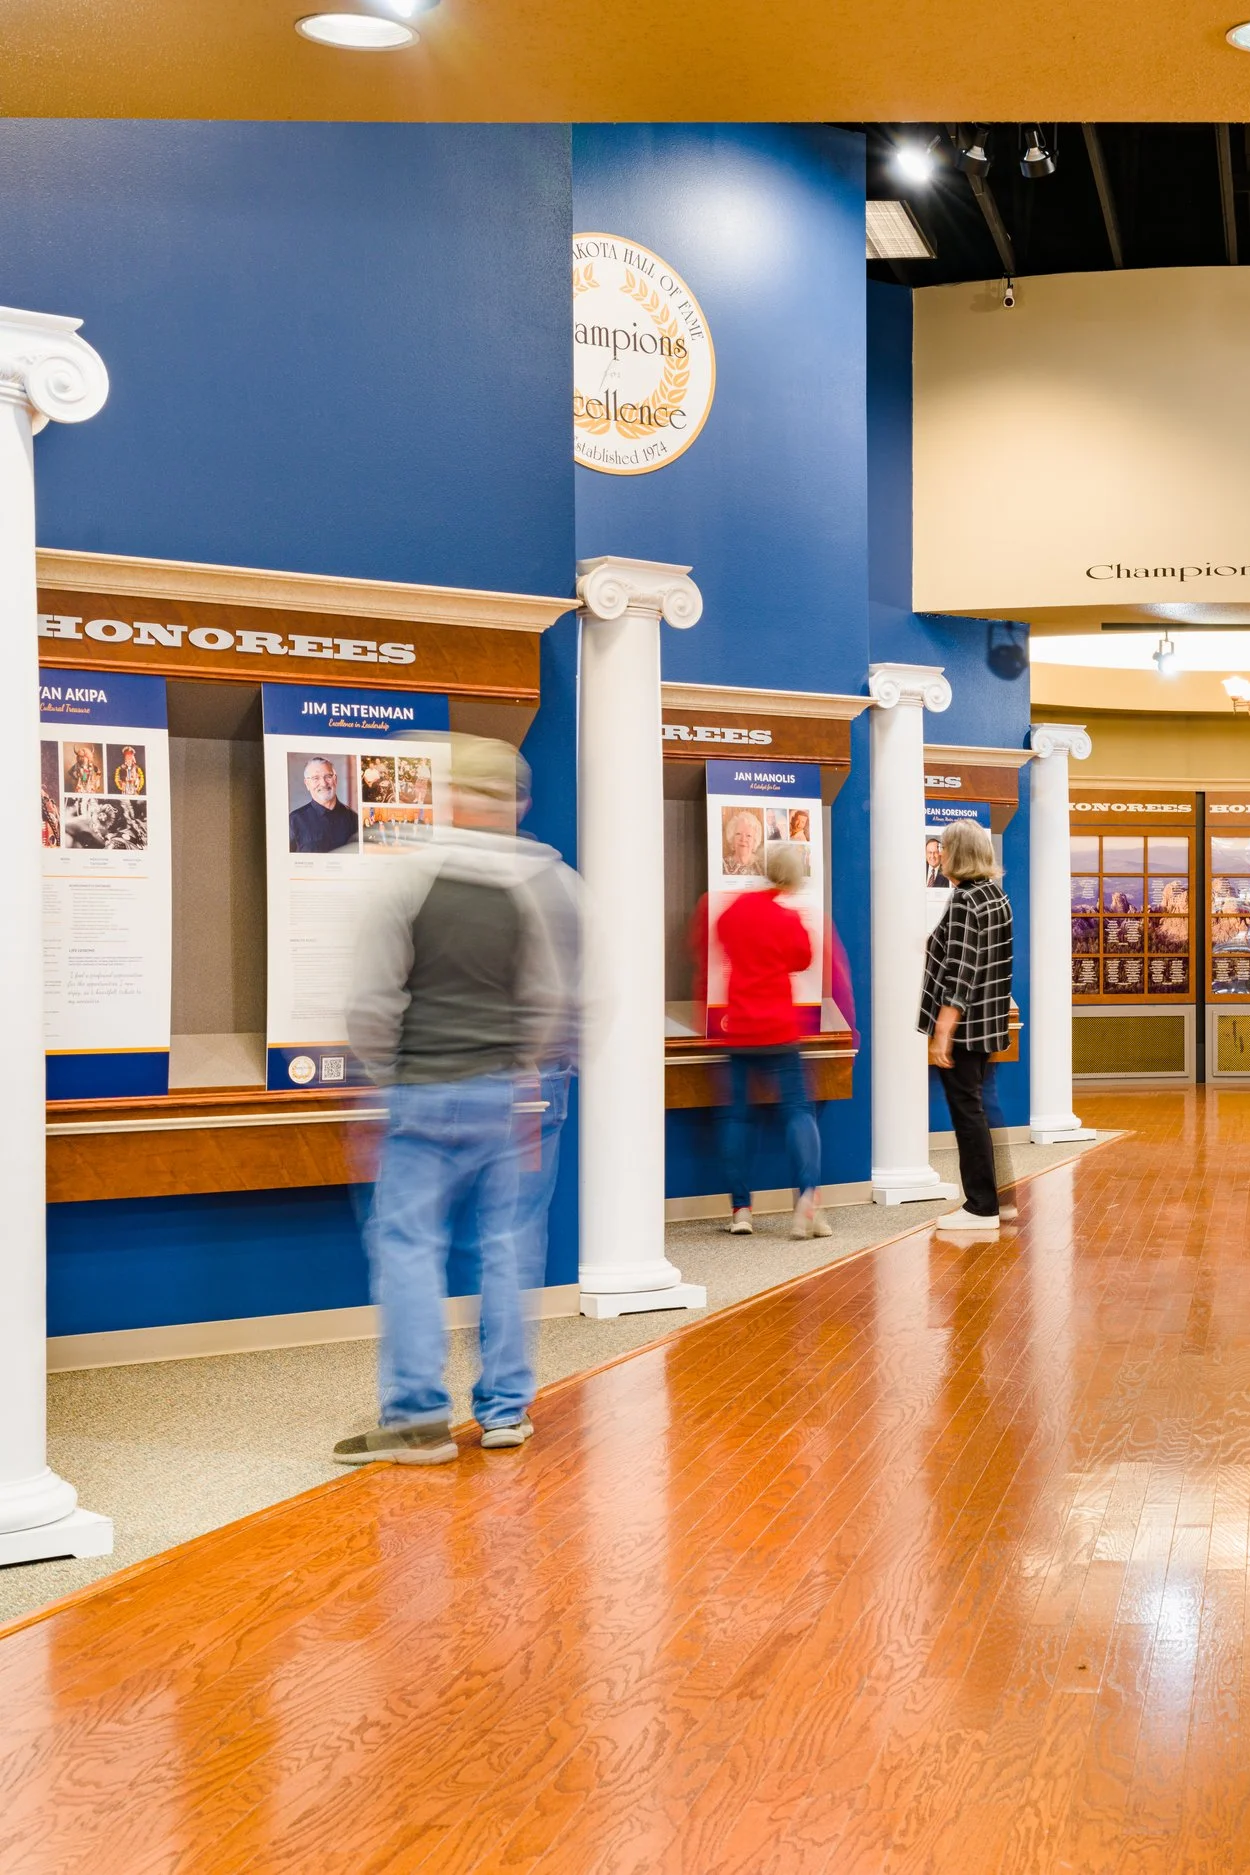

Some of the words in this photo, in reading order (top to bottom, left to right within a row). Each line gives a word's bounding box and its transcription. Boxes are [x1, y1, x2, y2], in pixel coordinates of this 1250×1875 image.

[623, 247, 655, 278] HALL
[659, 275, 683, 298] OF
[678, 301, 704, 341] FAME
[575, 322, 688, 361] ampions
[642, 440, 668, 461] 1974
[38, 613, 416, 665] HONOREES
[39, 686, 62, 700] AN
[65, 687, 108, 703] AKIPA
[301, 701, 327, 716] JIM
[331, 703, 414, 720] ENTENMAN
[328, 718, 354, 728] Excellence
[361, 720, 390, 731] Leadership
[734, 772, 752, 782] JAN
[754, 772, 796, 784] MANOLIS
[941, 808, 978, 818] SORENSON
